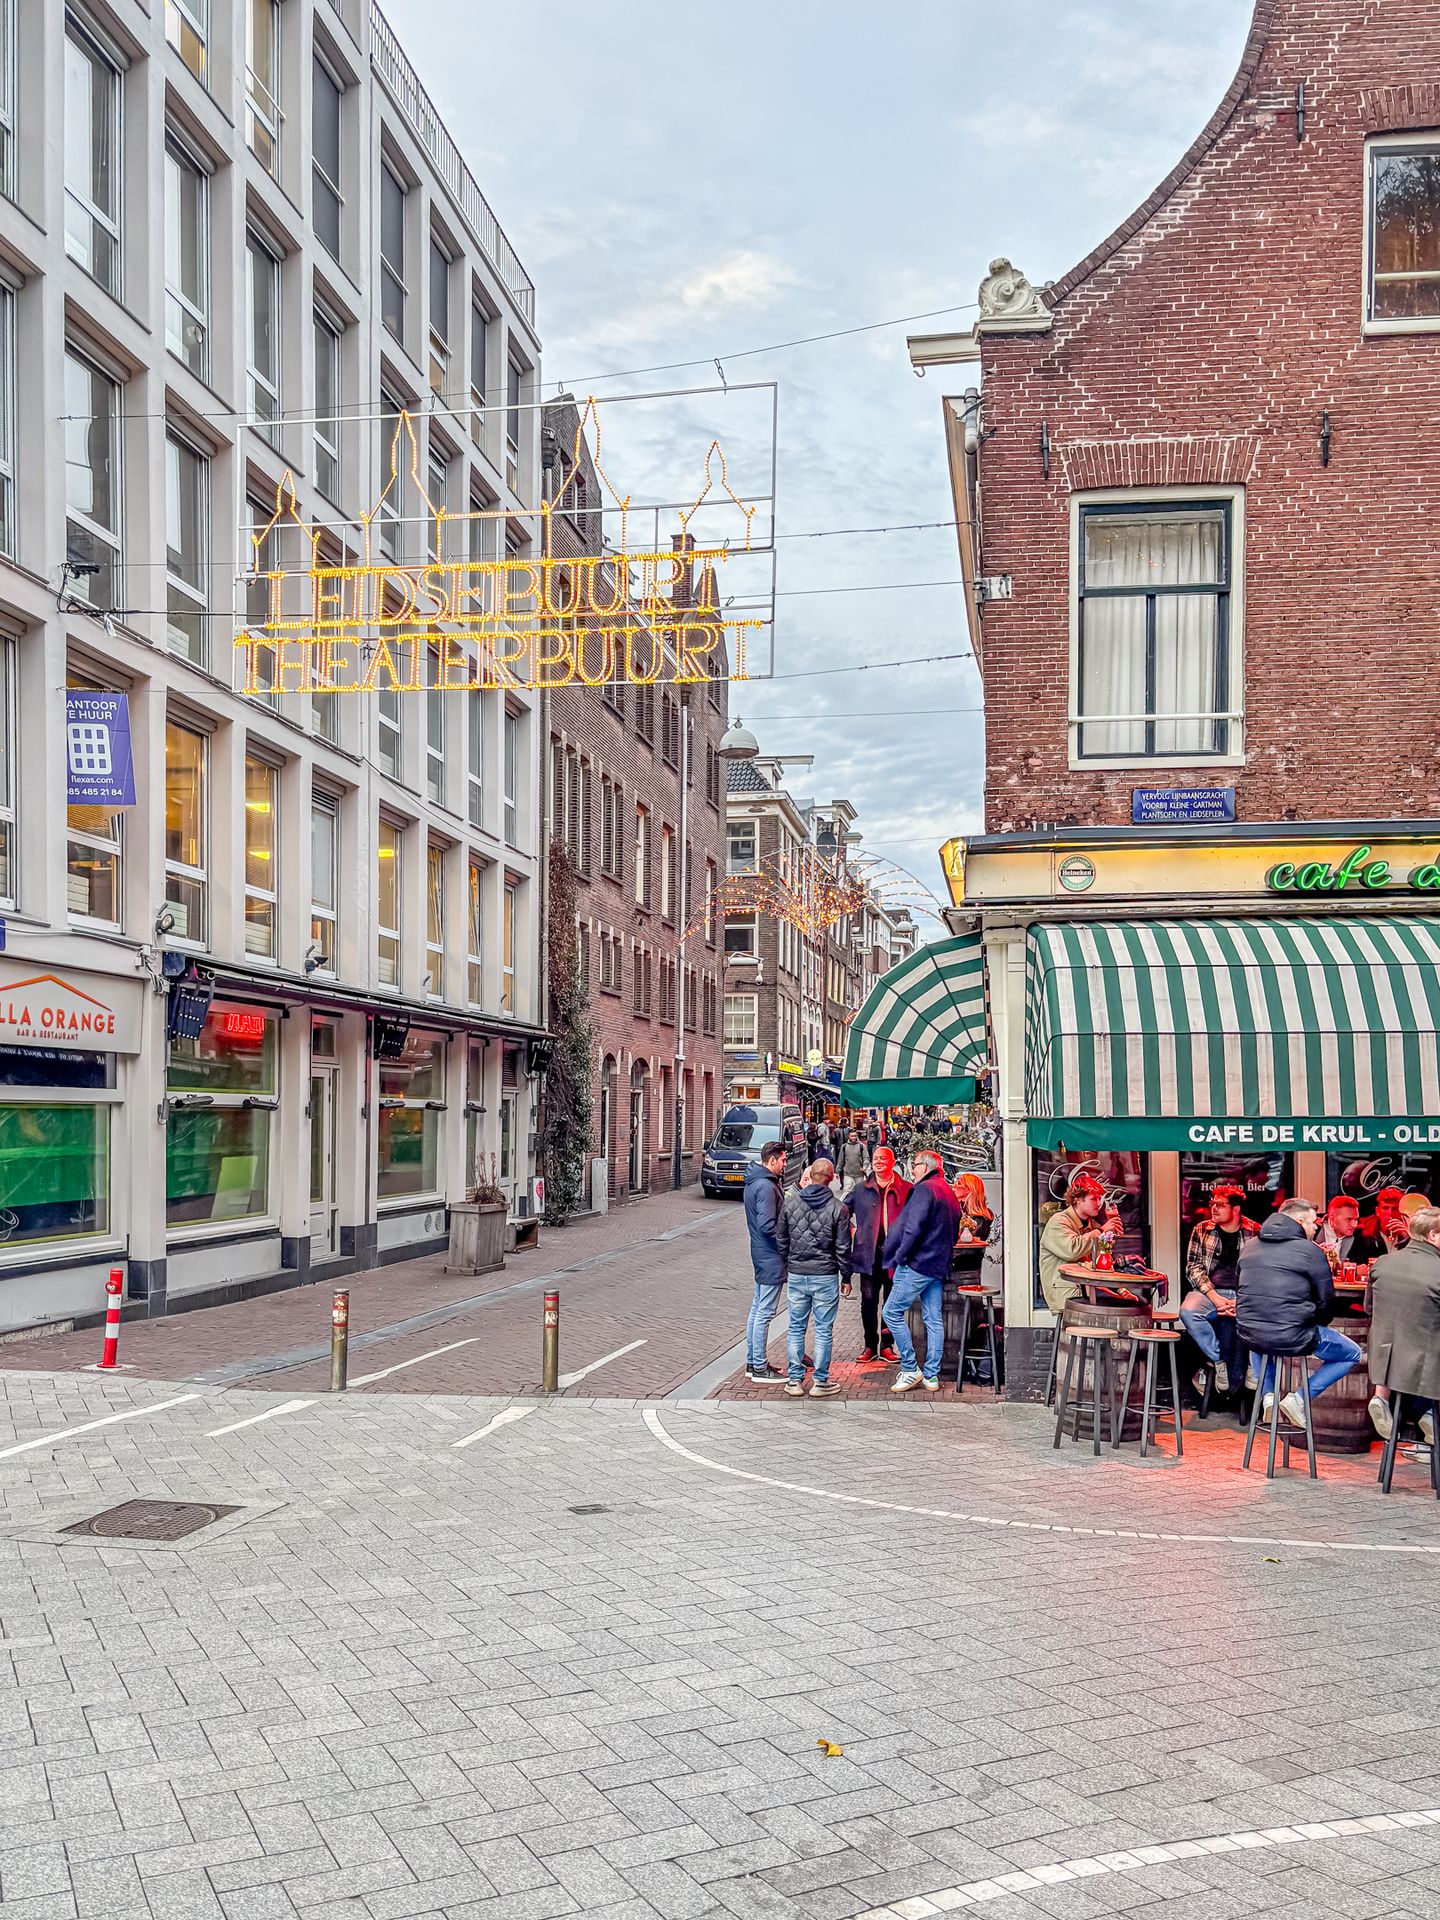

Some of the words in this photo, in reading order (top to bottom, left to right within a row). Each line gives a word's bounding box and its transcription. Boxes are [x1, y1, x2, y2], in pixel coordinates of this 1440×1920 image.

[265, 549, 728, 630] LEIDSEBUURT
[233, 619, 762, 693] THEATERBUURT
[79, 710, 113, 720] HUUR
[71, 775, 114, 784] flexas.com
[81, 788, 99, 796] 485
[111, 788, 123, 796] 84
[1141, 792, 1170, 801] VERVOLG
[1171, 791, 1227, 801] LIJNBAANSGRACHT
[1141, 802, 1168, 810] VOORBIJ
[1141, 811, 1177, 819] PLANTSOEN
[1189, 810, 1225, 818] LEIDSEPLEIN
[1266, 845, 1393, 889] cafe
[41, 1007, 115, 1034] ORANGE
[16, 1028, 29, 1037] BAR
[39, 1030, 79, 1041] RESTAURANT
[1189, 1125, 1254, 1143] CAFE
[1262, 1125, 1294, 1143] DE
[1303, 1125, 1371, 1143] KRUL
[1247, 1179, 1267, 1192] Bier
